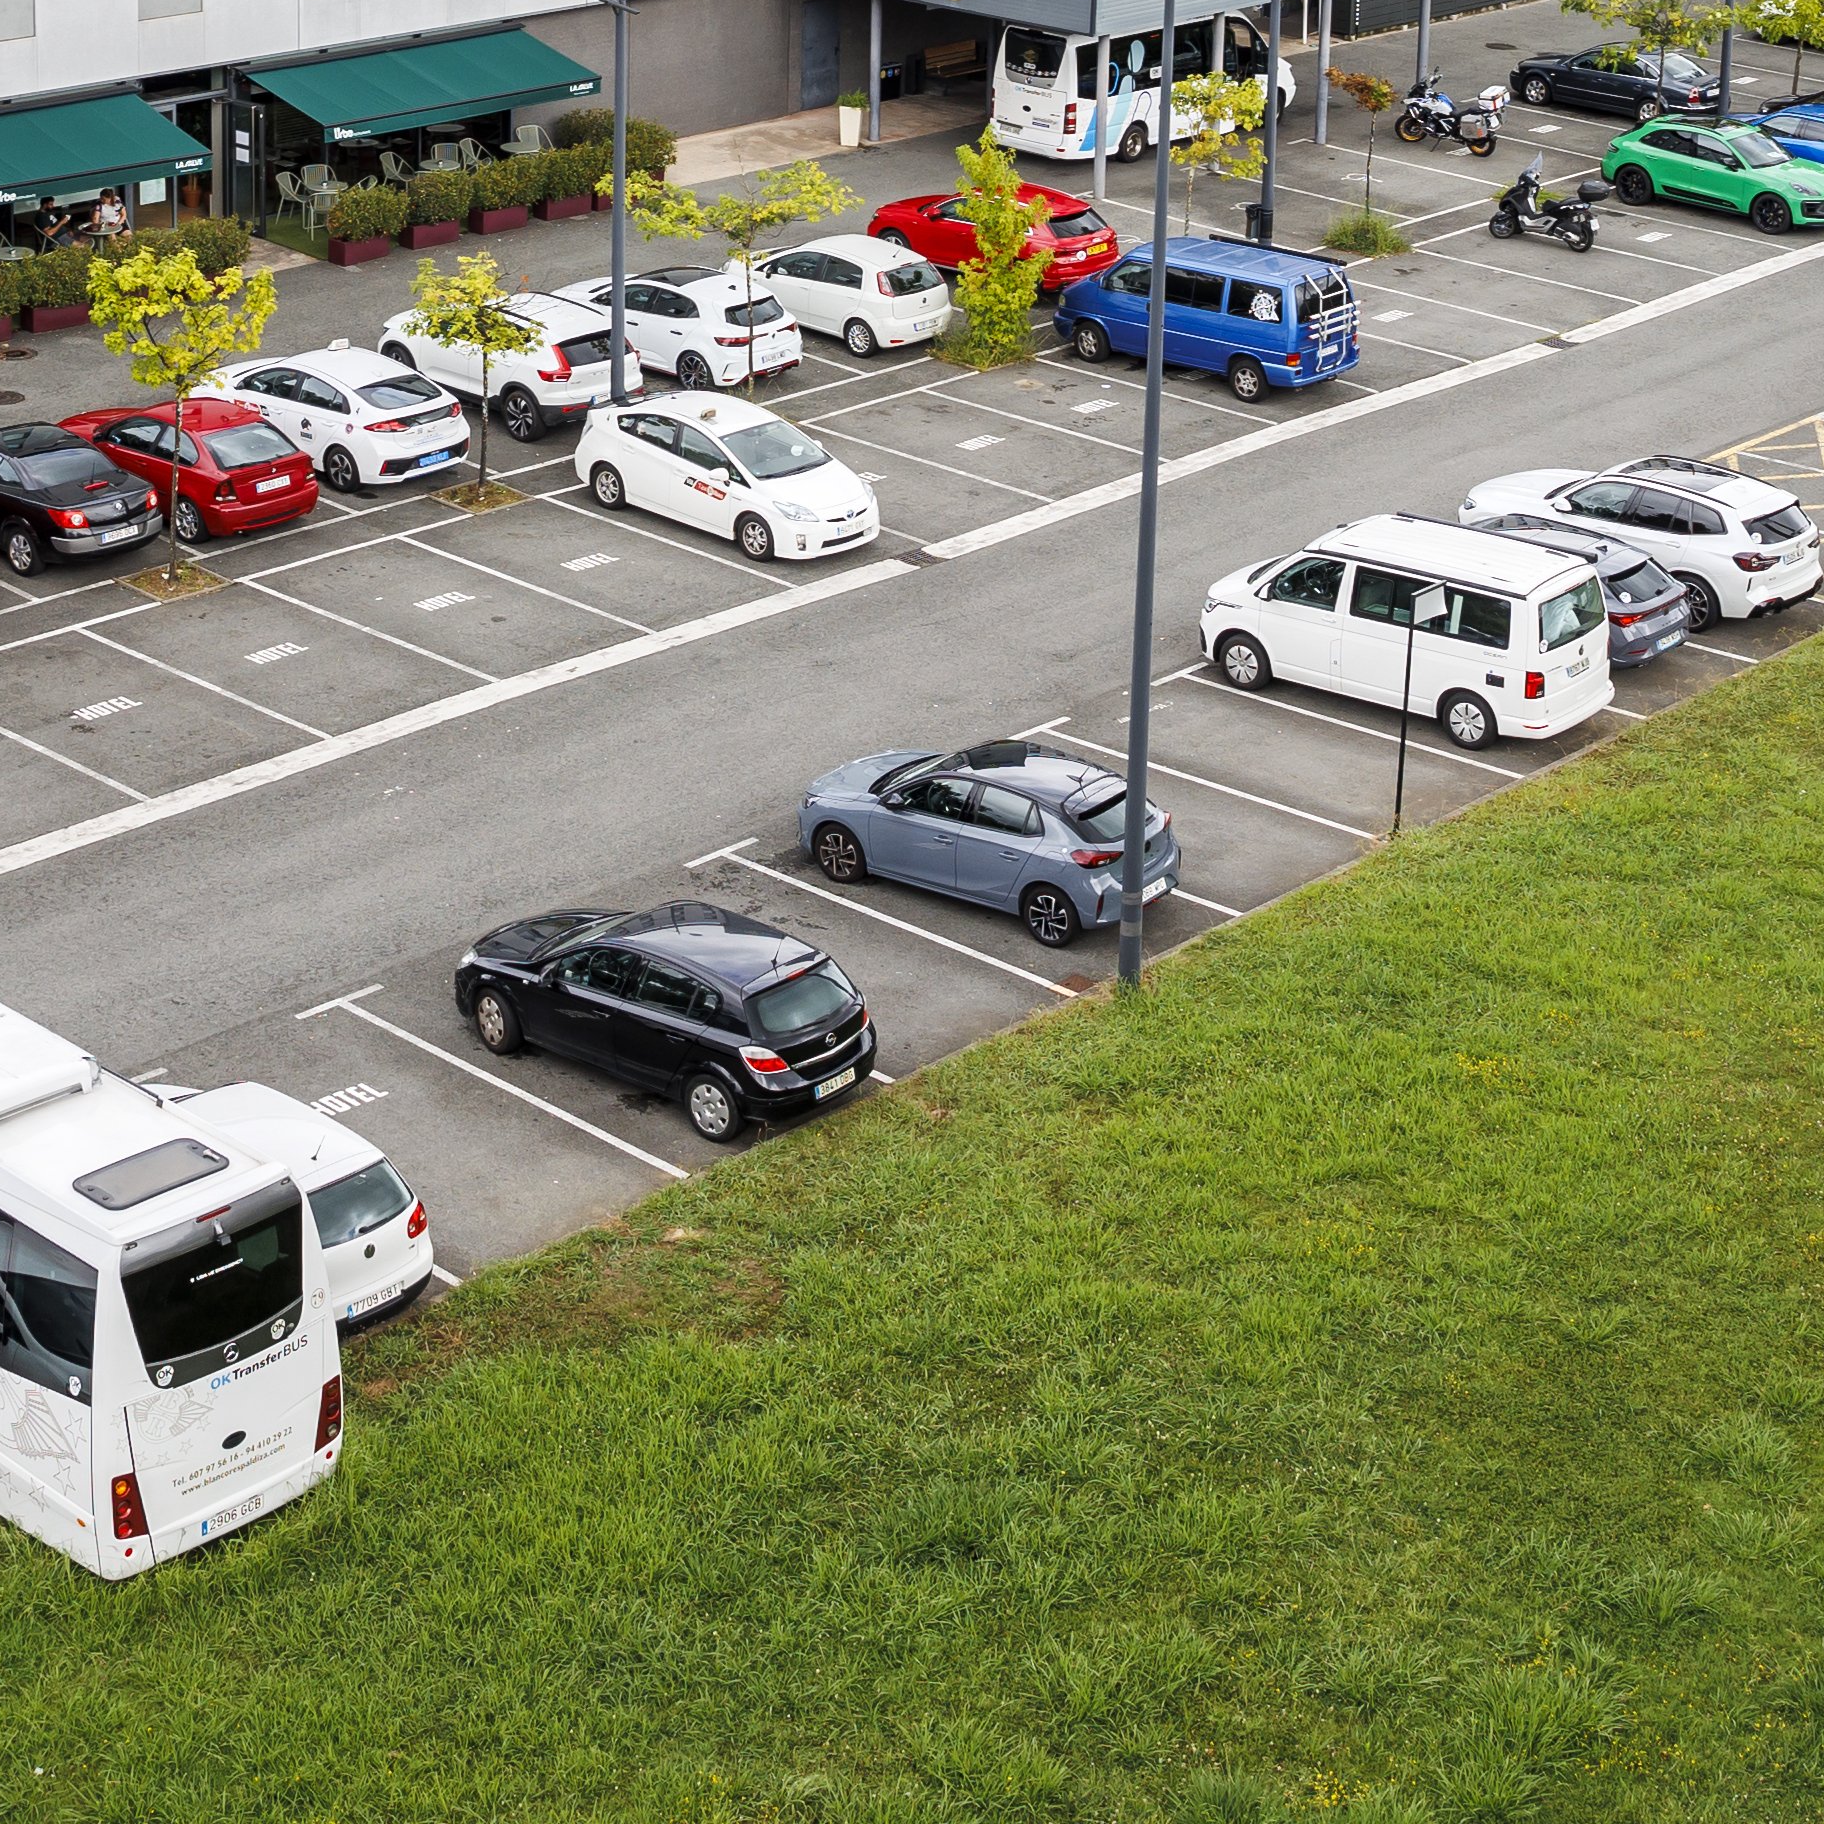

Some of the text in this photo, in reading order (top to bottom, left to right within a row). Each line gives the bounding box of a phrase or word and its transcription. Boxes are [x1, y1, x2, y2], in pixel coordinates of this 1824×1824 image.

[560, 553, 620, 572] HOTEL
[413, 591, 476, 612] HOTEL
[244, 642, 309, 664] HOTEL
[73, 696, 143, 720] HOTEL
[353, 1294, 379, 1312] 7709
[271, 1320, 286, 1333] OK
[157, 1367, 173, 1380] OK
[210, 1372, 231, 1390] OK
[172, 1477, 187, 1488] Tel.
[189, 1469, 203, 1480] 607
[206, 1463, 215, 1473] 97
[217, 1458, 227, 1468] 56
[229, 1452, 239, 1462] 16
[245, 1444, 255, 1455] 94
[257, 1436, 271, 1449] 410
[273, 1431, 282, 1442] 29
[283, 1426, 293, 1437] 22
[181, 1443, 286, 1496] www.blancorespaldiza.com
[209, 1497, 261, 1531] 2906 GCB
